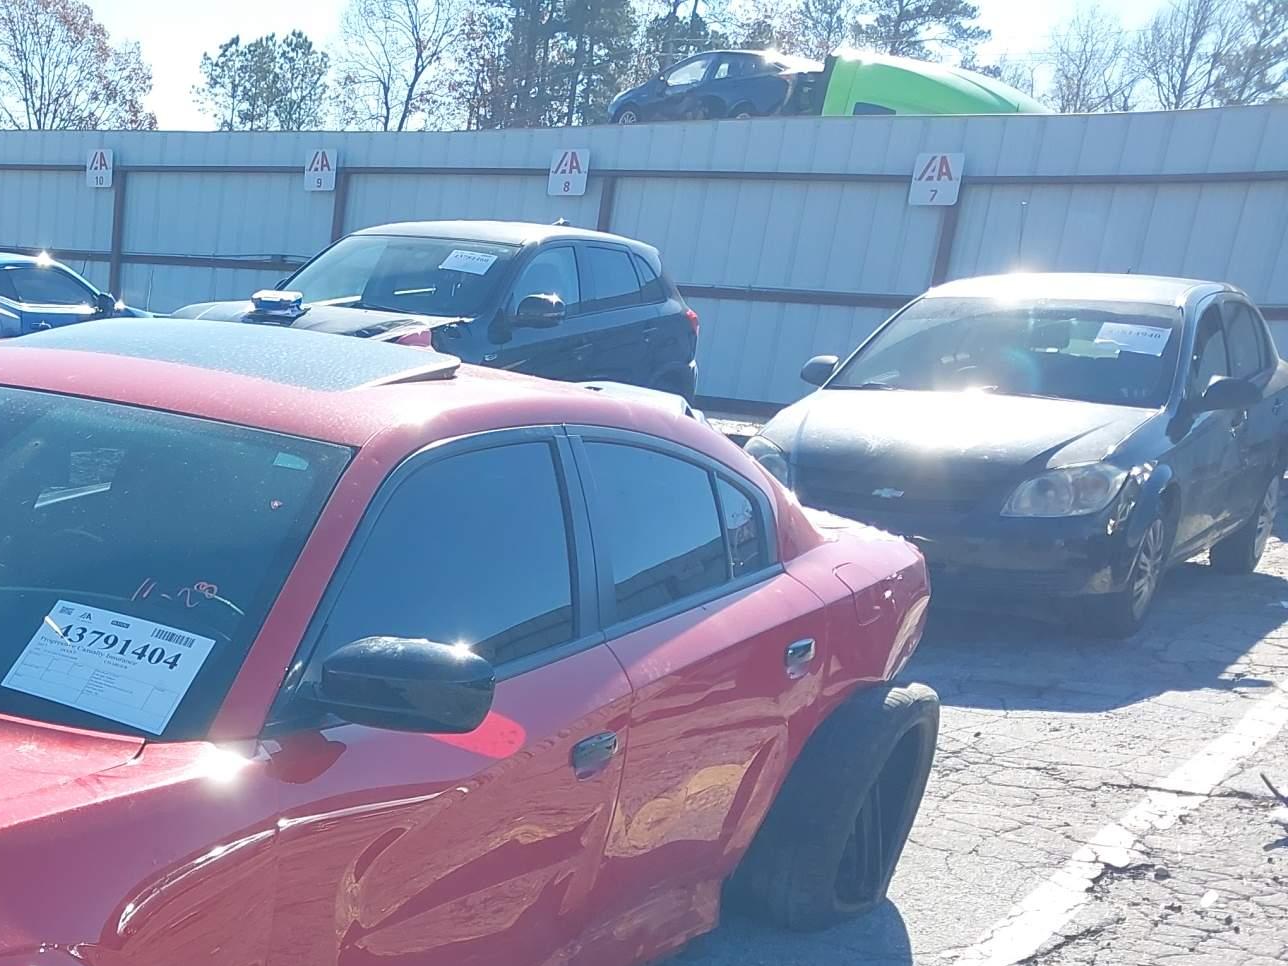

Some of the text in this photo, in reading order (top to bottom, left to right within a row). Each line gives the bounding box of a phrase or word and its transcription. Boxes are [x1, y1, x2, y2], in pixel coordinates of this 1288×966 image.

[95, 175, 104, 186] 10
[316, 178, 322, 188] 9
[562, 181, 571, 193] 8
[929, 188, 939, 202] 7
[60, 623, 182, 670] 43791404
